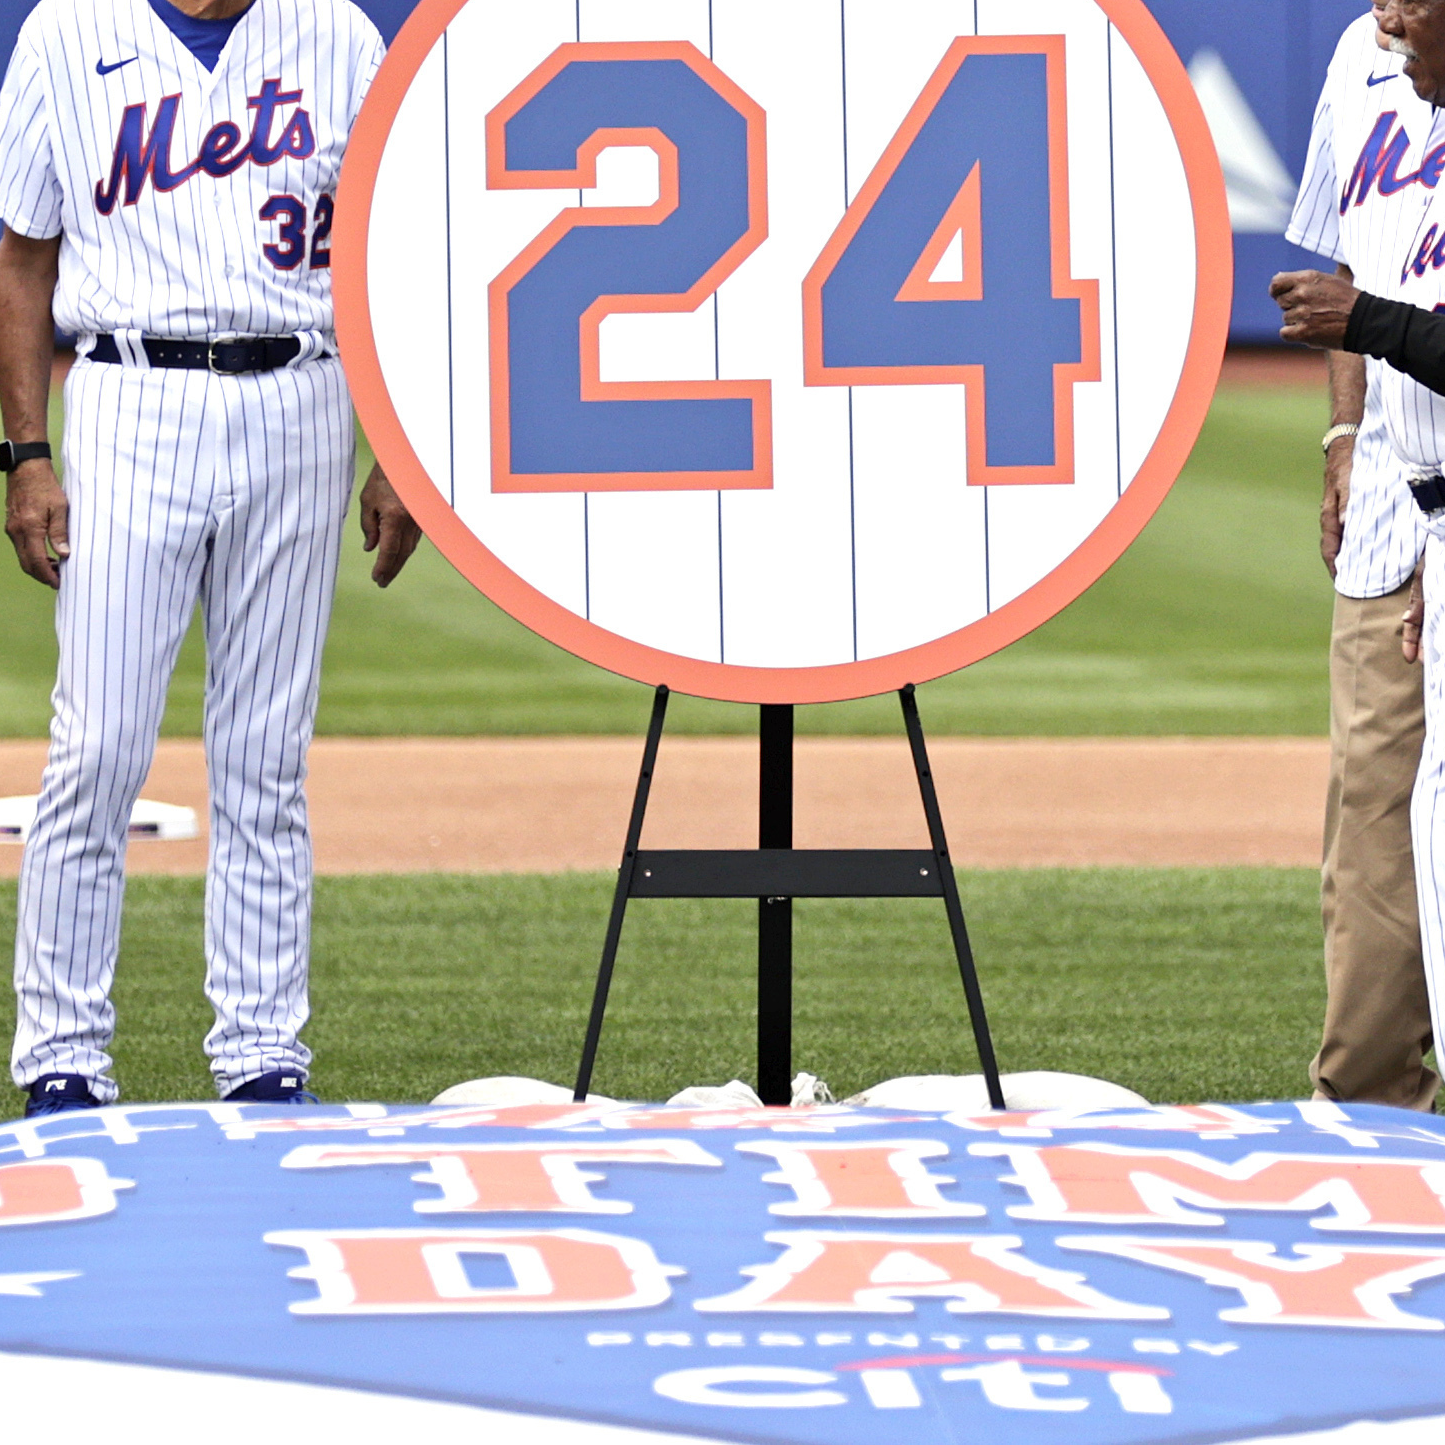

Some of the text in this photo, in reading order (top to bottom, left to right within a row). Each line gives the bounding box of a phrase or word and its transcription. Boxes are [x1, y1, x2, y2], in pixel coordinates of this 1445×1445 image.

[95, 78, 315, 216] Mets
[259, 192, 334, 271] 32
[485, 33, 1102, 493] 24
[586, 1330, 1241, 1356] PRESENTED BY
